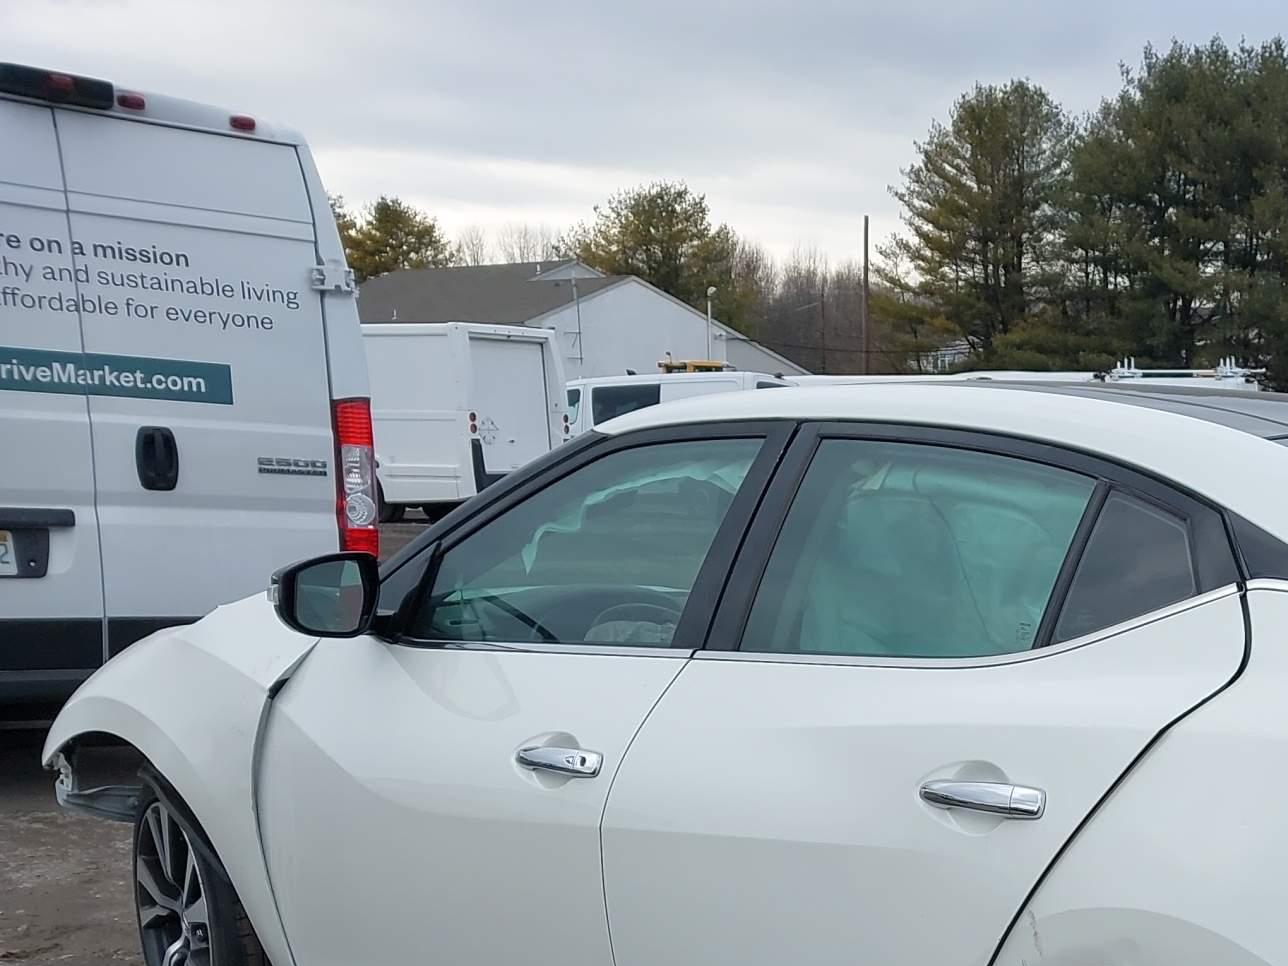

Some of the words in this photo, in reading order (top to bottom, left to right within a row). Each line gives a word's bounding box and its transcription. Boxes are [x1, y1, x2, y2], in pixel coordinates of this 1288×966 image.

[0, 233, 21, 249] e
[29, 237, 63, 255] on
[71, 240, 87, 256] a
[92, 241, 190, 268] mission
[0, 255, 34, 283] hy
[42, 263, 90, 284] and
[97, 270, 235, 299] sustainable
[240, 280, 300, 310] living
[0, 286, 119, 316] ffordable
[125, 297, 160, 319] for
[165, 306, 274, 331] everyone
